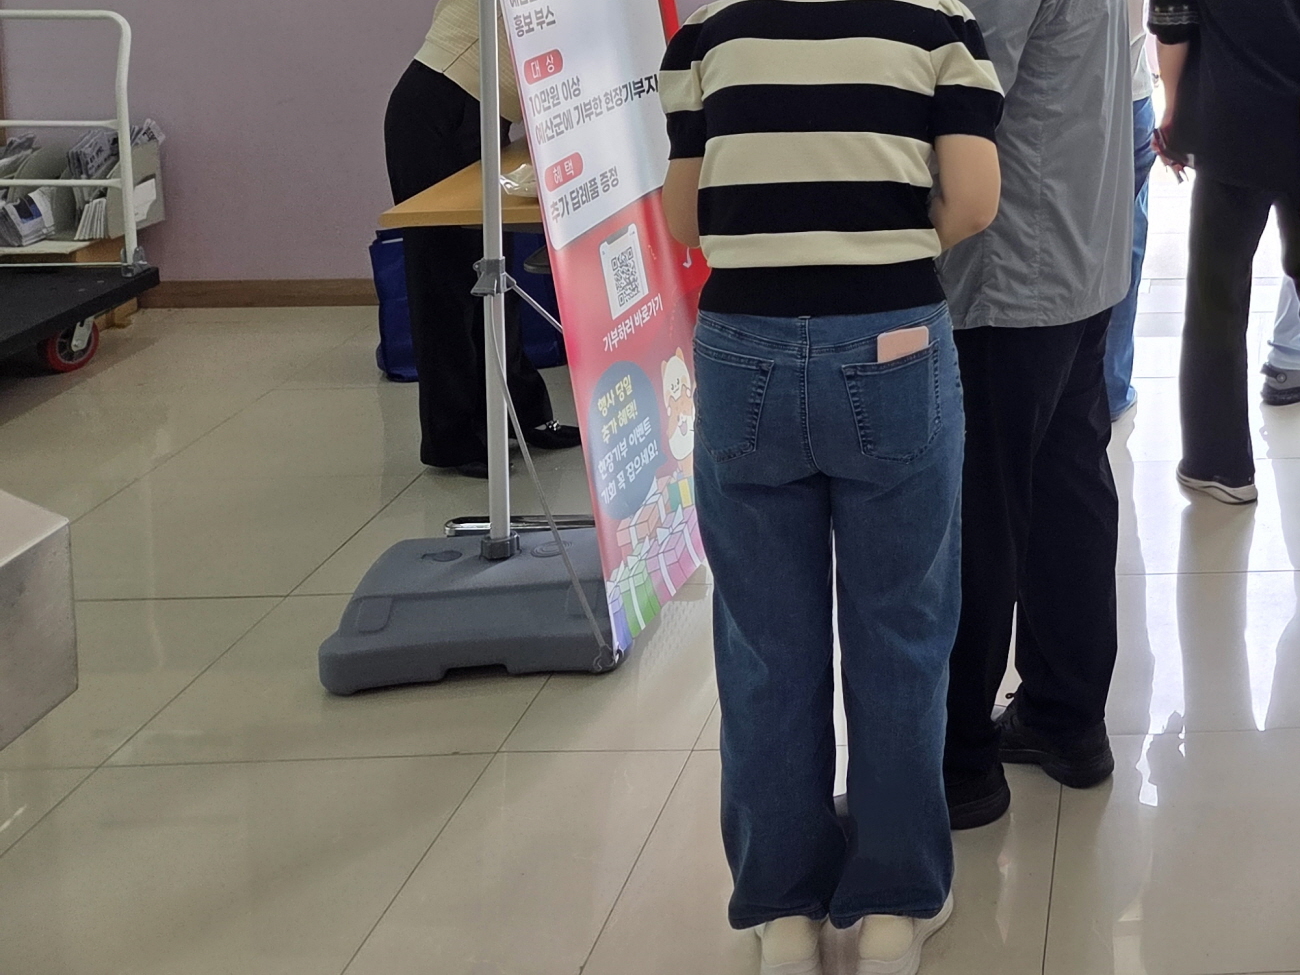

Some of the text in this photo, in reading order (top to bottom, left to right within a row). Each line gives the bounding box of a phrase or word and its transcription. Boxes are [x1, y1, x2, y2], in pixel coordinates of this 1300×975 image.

[513, 5, 556, 37] 홍보 부스
[529, 75, 581, 117] 10만원 이상
[535, 109, 574, 145] 예산군에
[573, 95, 603, 125] 기부한
[550, 166, 619, 223] 추가 답례품 증정
[602, 293, 663, 352] 기부하러 바로가기
[597, 375, 633, 417] 행사 당일
[628, 416, 652, 446] 이벤트
